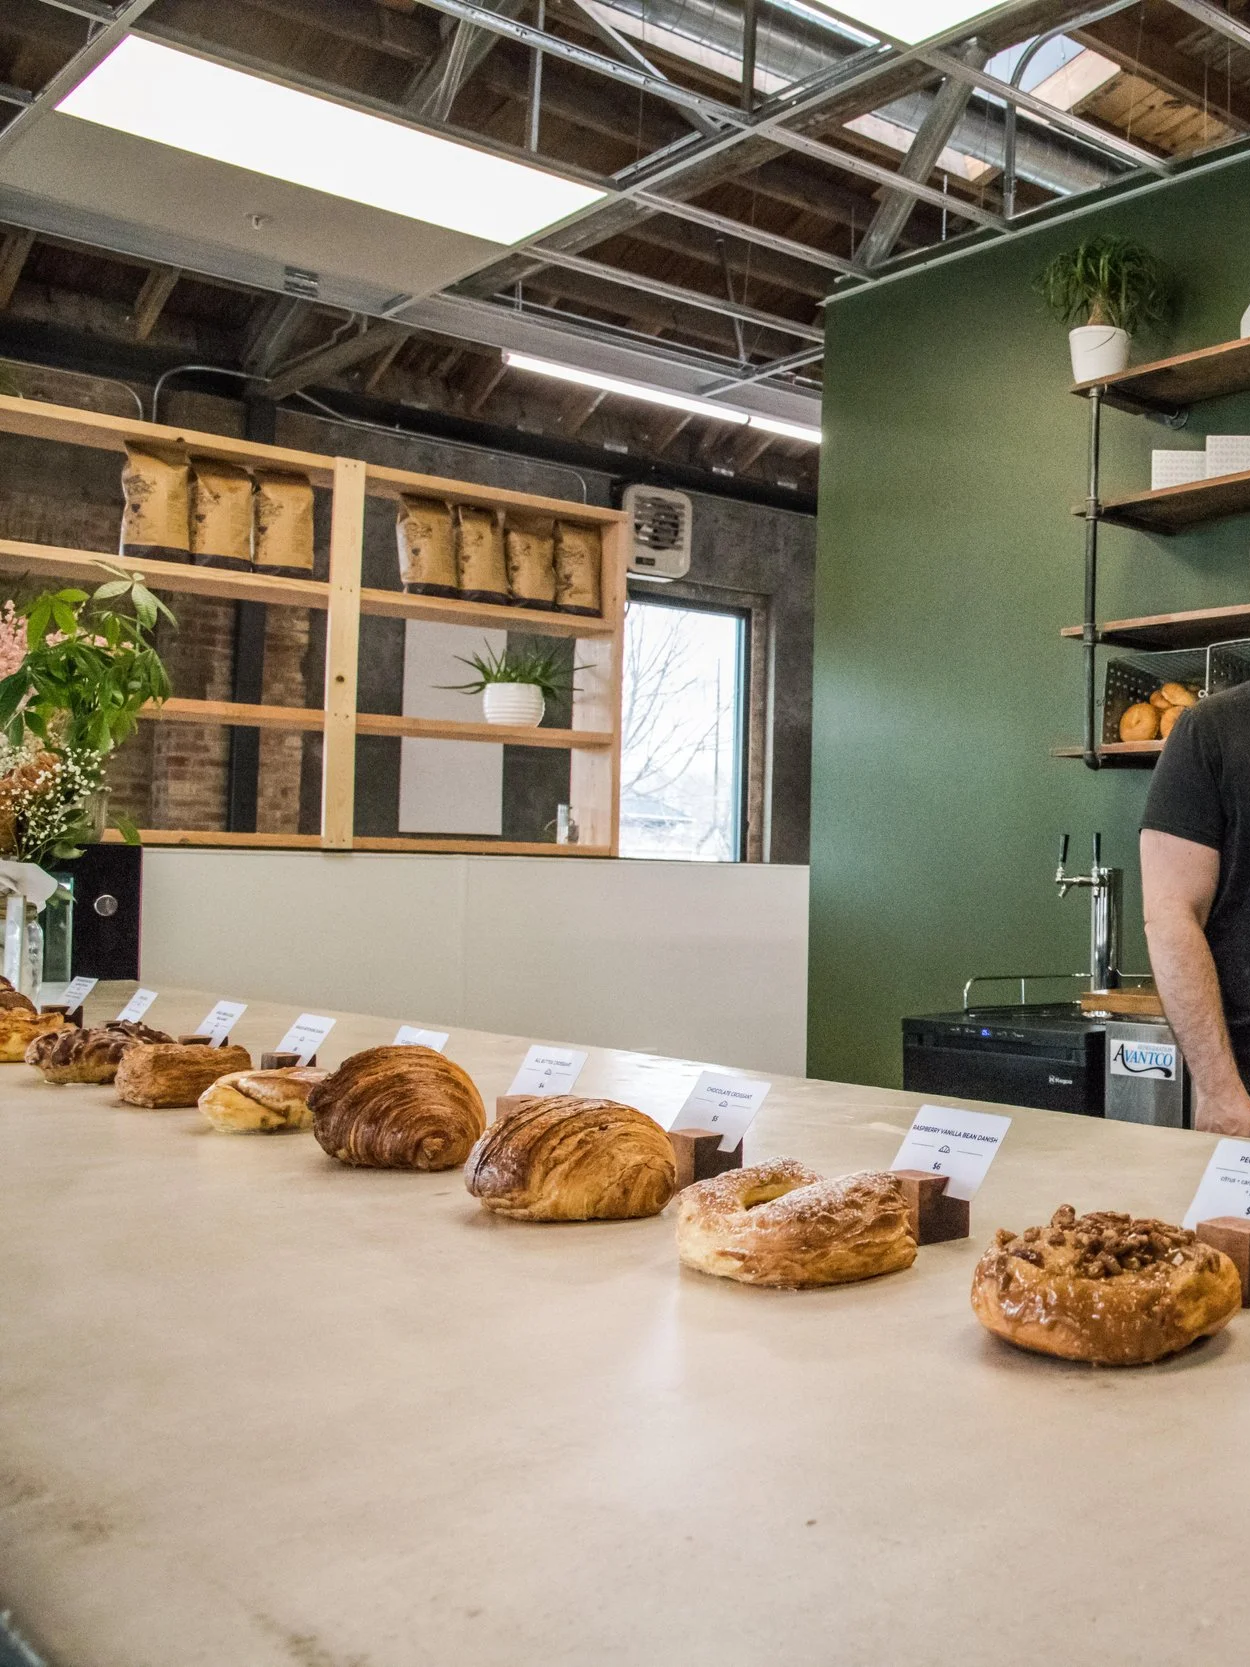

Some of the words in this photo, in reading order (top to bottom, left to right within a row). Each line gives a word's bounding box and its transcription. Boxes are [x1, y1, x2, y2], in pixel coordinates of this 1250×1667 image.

[1113, 1043, 1173, 1078] AVANTCO
[706, 1086, 731, 1097] CHOCOLATE
[913, 1125, 940, 1133] RASPBERRY
[940, 1128, 962, 1137] VANILLA
[962, 1132, 977, 1140] BEAN
[977, 1134, 998, 1143] DANISH
[932, 1161, 942, 1170] $6
[1220, 1175, 1236, 1183] citrus
